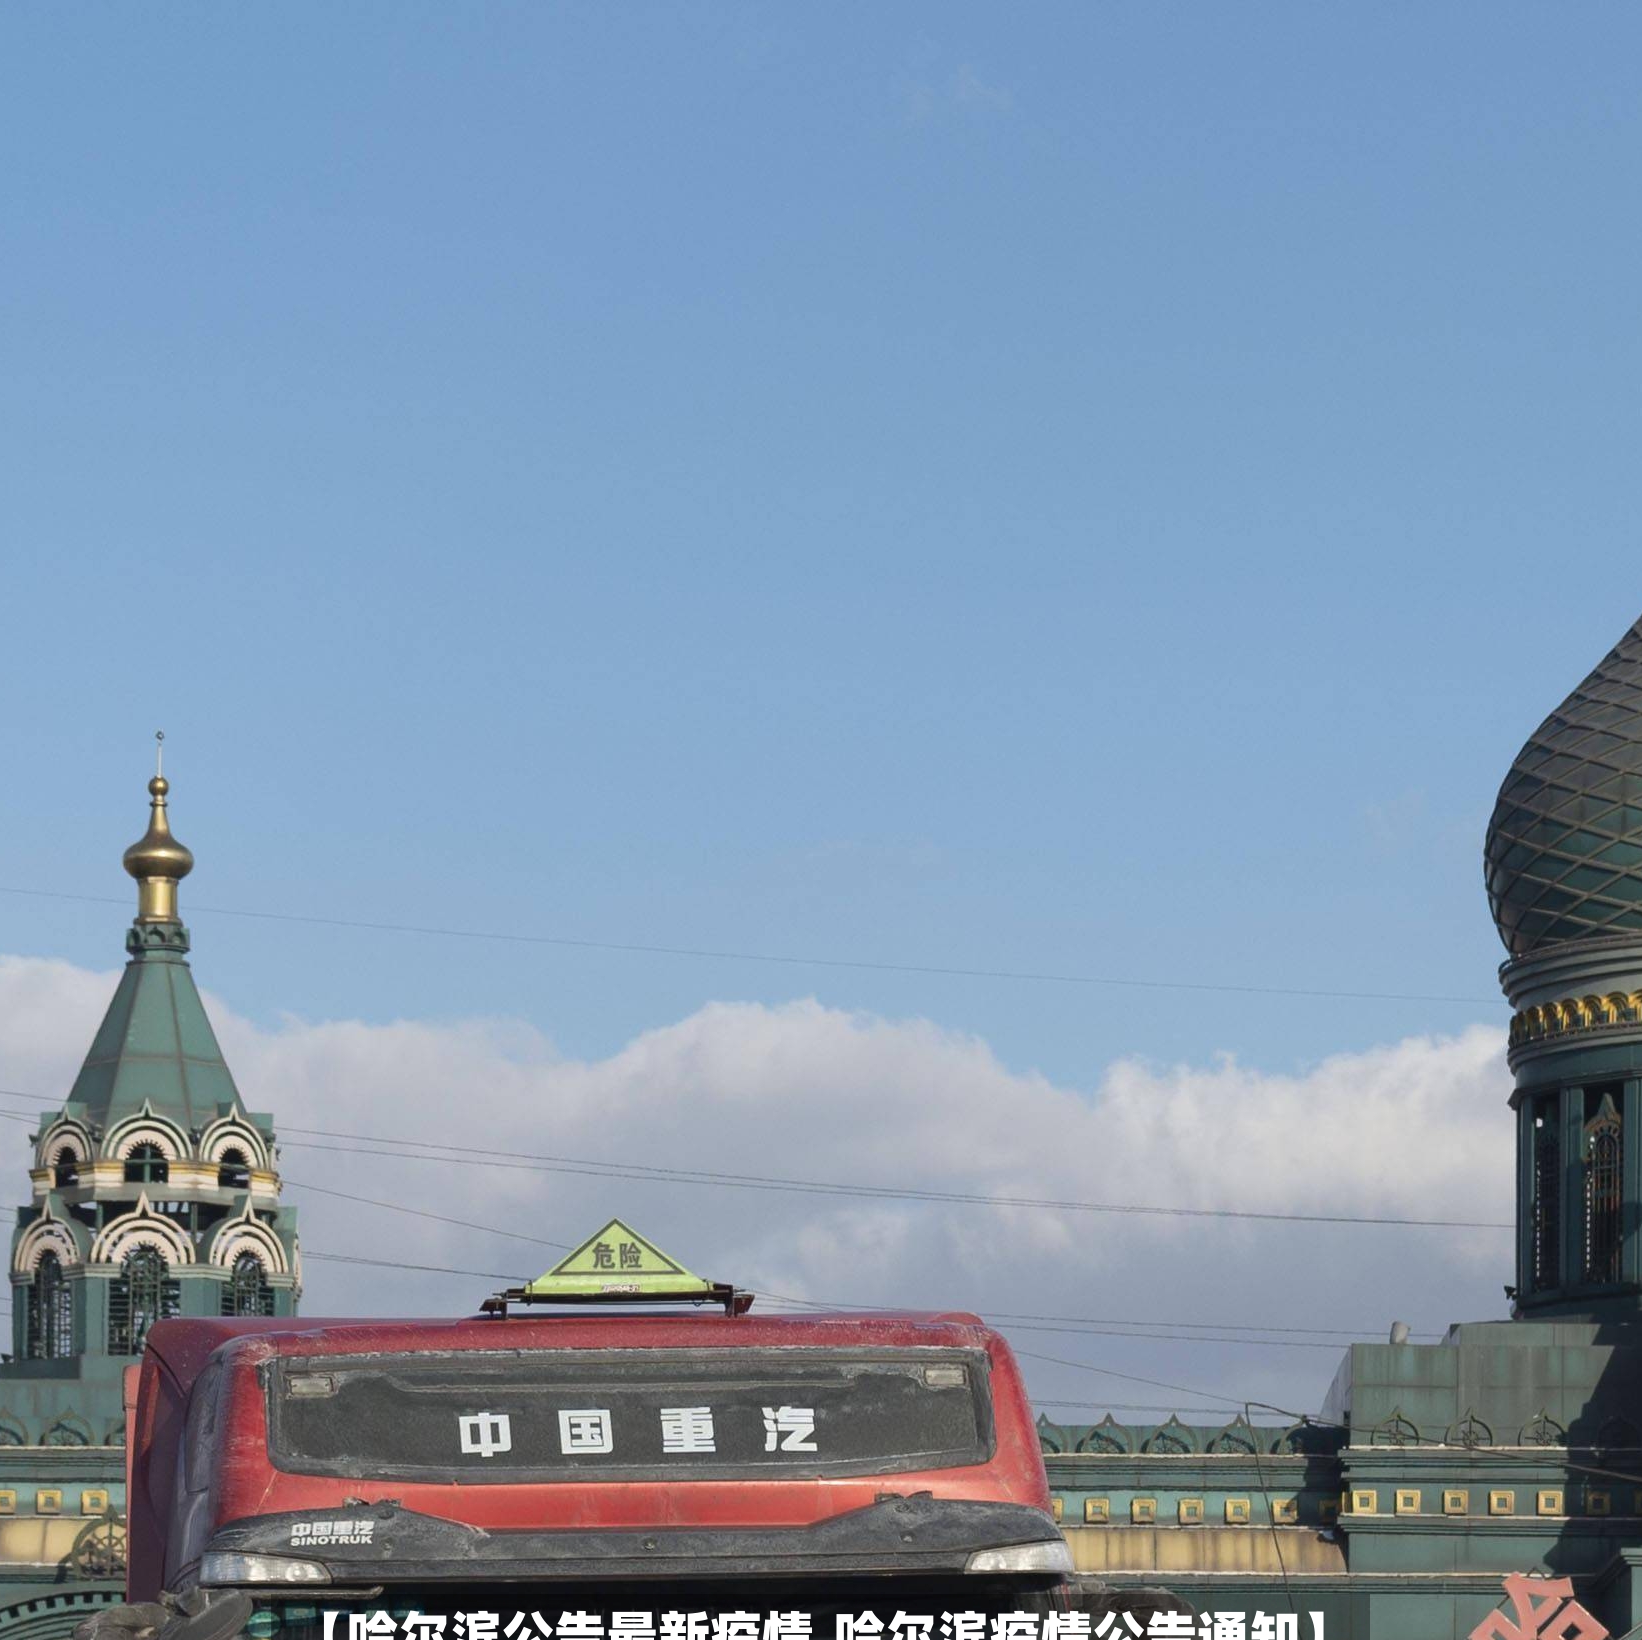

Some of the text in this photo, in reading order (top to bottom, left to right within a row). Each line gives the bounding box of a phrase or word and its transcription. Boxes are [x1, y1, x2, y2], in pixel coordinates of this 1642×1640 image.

[592, 1242, 642, 1269] 危险
[458, 1405, 818, 1457] 中国重汽
[291, 1520, 375, 1537] 中国重汽
[290, 1535, 373, 1546] SINOTRUK
